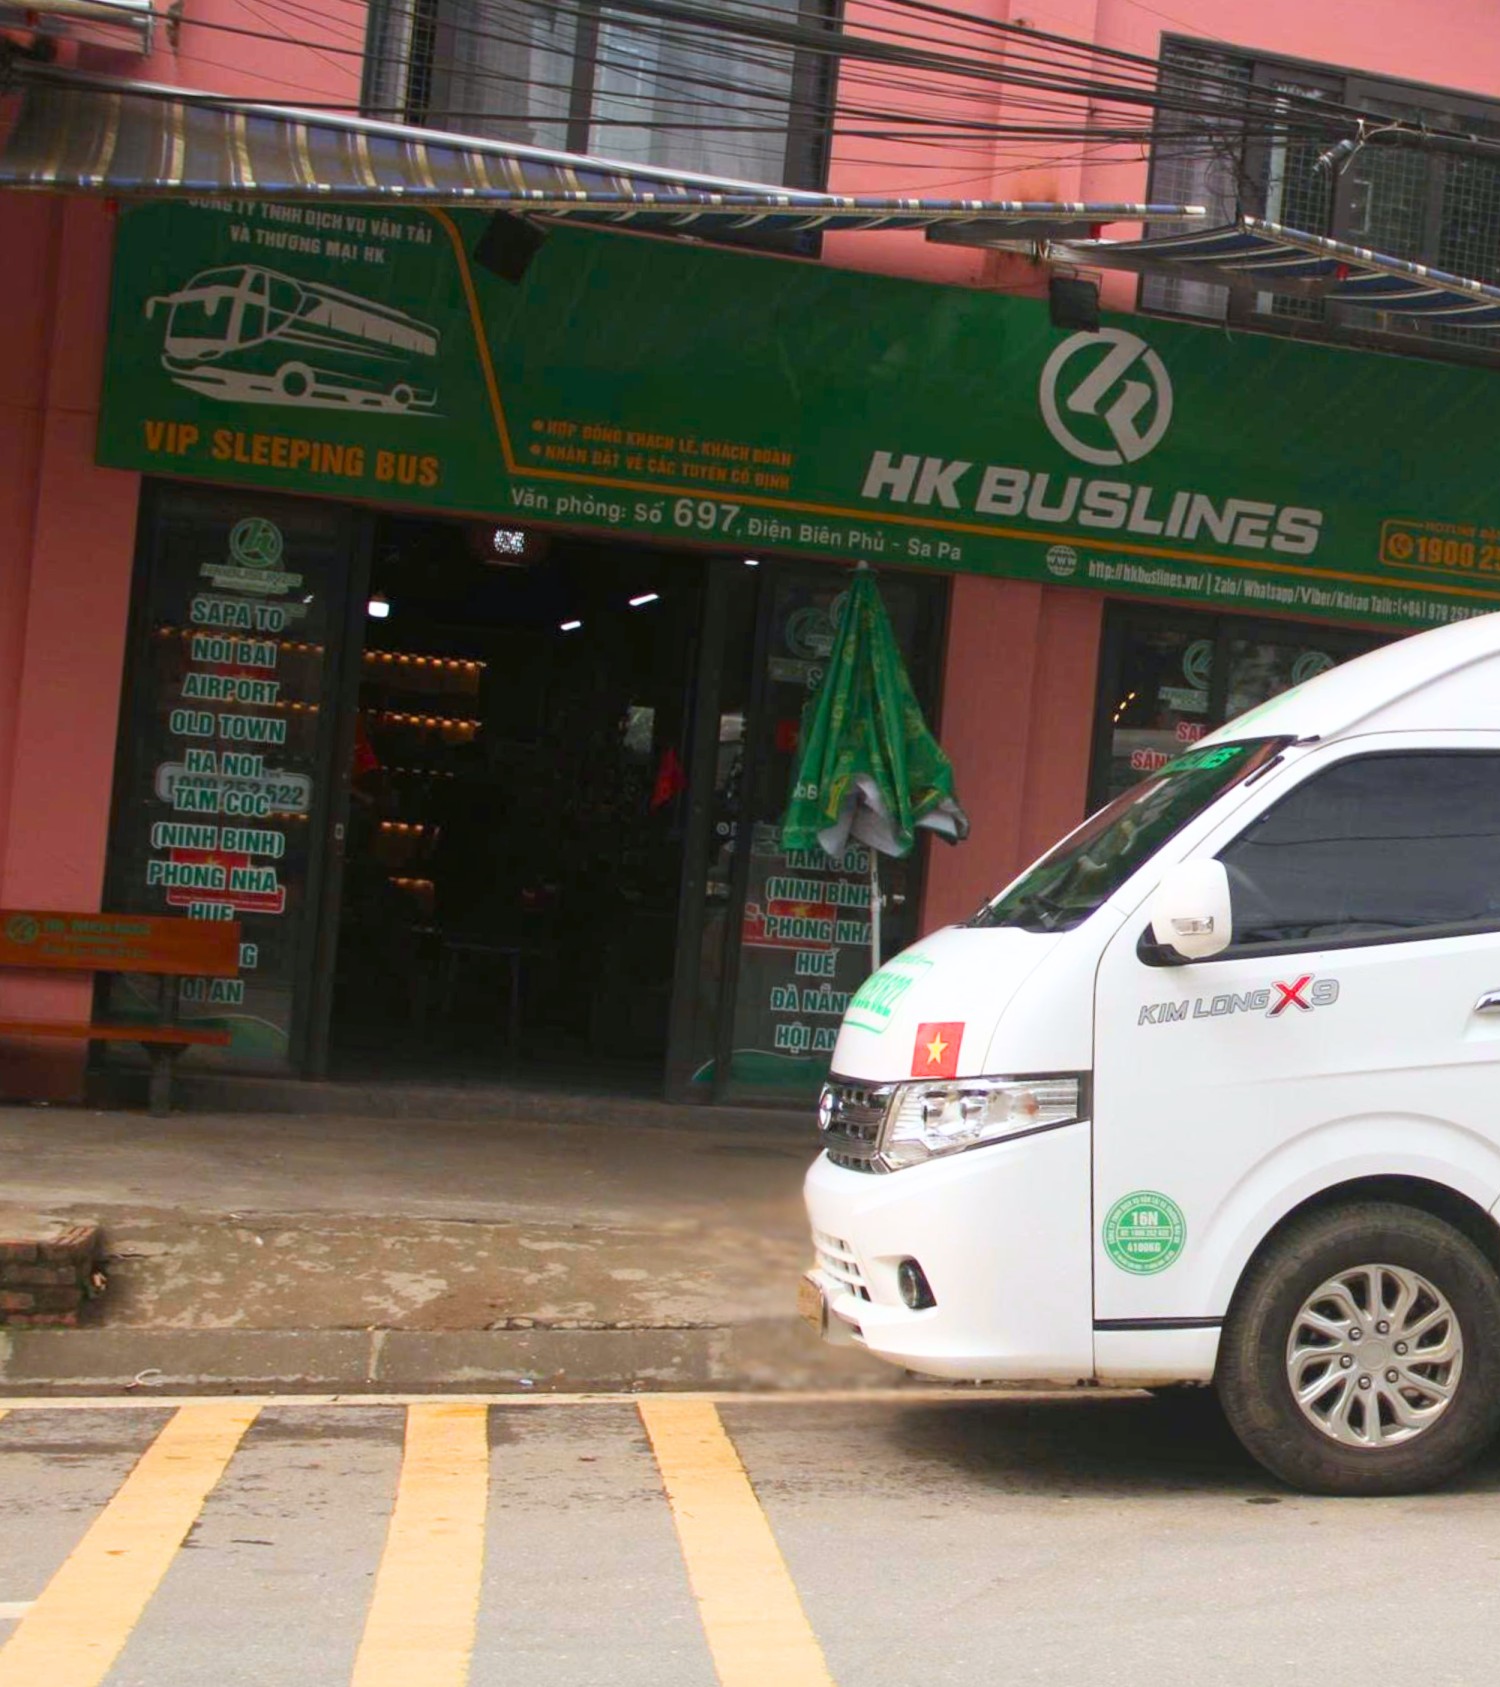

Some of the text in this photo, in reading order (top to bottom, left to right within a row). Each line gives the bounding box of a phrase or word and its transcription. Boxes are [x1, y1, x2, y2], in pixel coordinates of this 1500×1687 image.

[261, 203, 303, 223] TNHH
[345, 216, 367, 238] VỤ
[406, 220, 432, 244] TẢI
[230, 221, 385, 264] VÀ THƯƠNG MẠI HK
[144, 420, 438, 486] VIP SLEEPING BUS
[860, 450, 1324, 555] HK BUSLINES
[511, 486, 548, 510] Văn
[555, 494, 626, 523] phòng:
[634, 501, 665, 524] Số
[748, 518, 792, 542] Điện
[799, 522, 841, 547] Biên
[848, 526, 885, 552] Phủ
[907, 538, 932, 559] Sa
[938, 540, 961, 562] Pa
[1418, 535, 1475, 567] 1900
[191, 598, 285, 632] SAPA TO
[192, 638, 277, 668] NOI BAI
[182, 673, 279, 706] AIRPORT
[170, 709, 286, 744] OLD TOWN
[186, 749, 263, 778] HA NOI
[174, 786, 270, 817] TAM COC
[151, 822, 285, 858] (NINH BINH)
[146, 860, 277, 893] PHONG NHA
[766, 876, 822, 903] (NINH
[765, 915, 832, 942] PHONG
[795, 947, 840, 977] HUẾ
[209, 979, 244, 1004] AN
[770, 983, 799, 1012] ĐÀ
[1138, 1000, 1189, 1026] KIM
[1193, 988, 1271, 1019] LONG
[774, 1021, 811, 1054] HỘI
[1131, 1211, 1159, 1226] 16N
